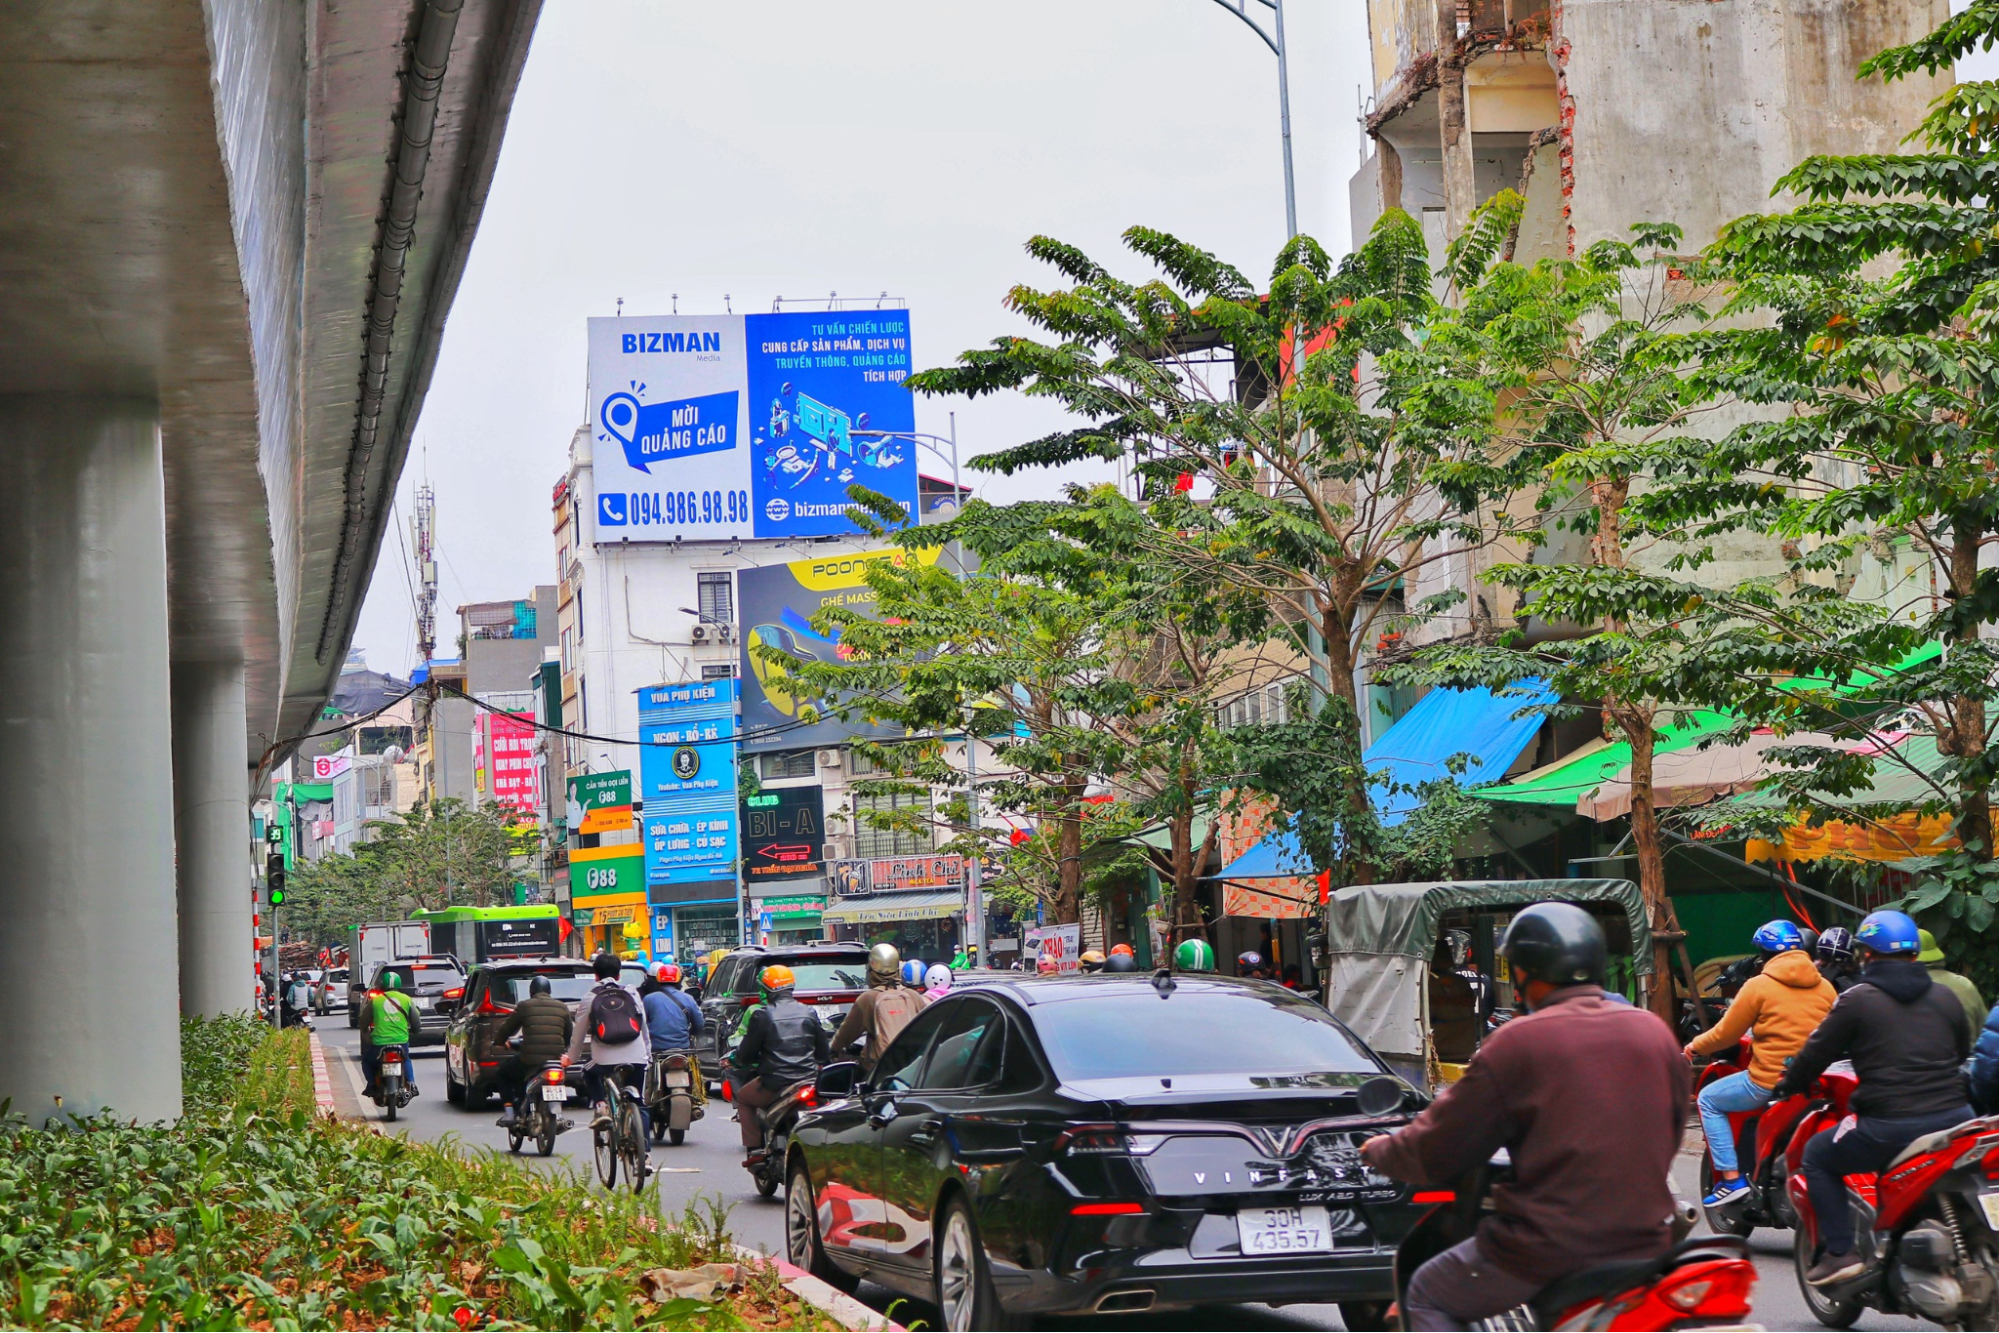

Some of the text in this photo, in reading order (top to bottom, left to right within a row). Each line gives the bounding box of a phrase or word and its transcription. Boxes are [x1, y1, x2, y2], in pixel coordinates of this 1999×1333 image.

[812, 320, 904, 335] TƯ VẤN CHIẾN LƯỢC
[622, 332, 720, 353] BIZMAN
[762, 336, 905, 353] CUNG CẤP SẢN PHẨM, DỊCH VỤ
[696, 354, 720, 362] Media
[775, 352, 906, 369] TRUYỀN THÔNG, QUẢNG CÁO
[863, 369, 907, 383] TÍCH HỢP
[671, 404, 698, 428] MỜI
[641, 422, 726, 454] QUẢNG CÁO
[630, 490, 748, 526] 094.986.98.98
[820, 592, 844, 607] GHẾ
[651, 685, 716, 703] VUA PHỤ KIỆN
[653, 731, 680, 744] NGON
[598, 790, 616, 804] F88
[748, 795, 779, 806] CLUB
[650, 818, 729, 836] SỬA CHỮA ÉP KÍNH
[654, 834, 726, 851] ỐP LƯNG CỦ SẠC
[932, 860, 960, 877] Chi
[587, 867, 617, 889] F88
[655, 911, 669, 930] ÉP
[655, 934, 672, 953] KÍNH
[1194, 1165, 1370, 1184] VINFAST
[1299, 1193, 1323, 1201] LUX
[1360, 1190, 1397, 1198] TURBO
[1264, 1209, 1303, 1228] 30H
[1253, 1230, 1321, 1250] 435.57
